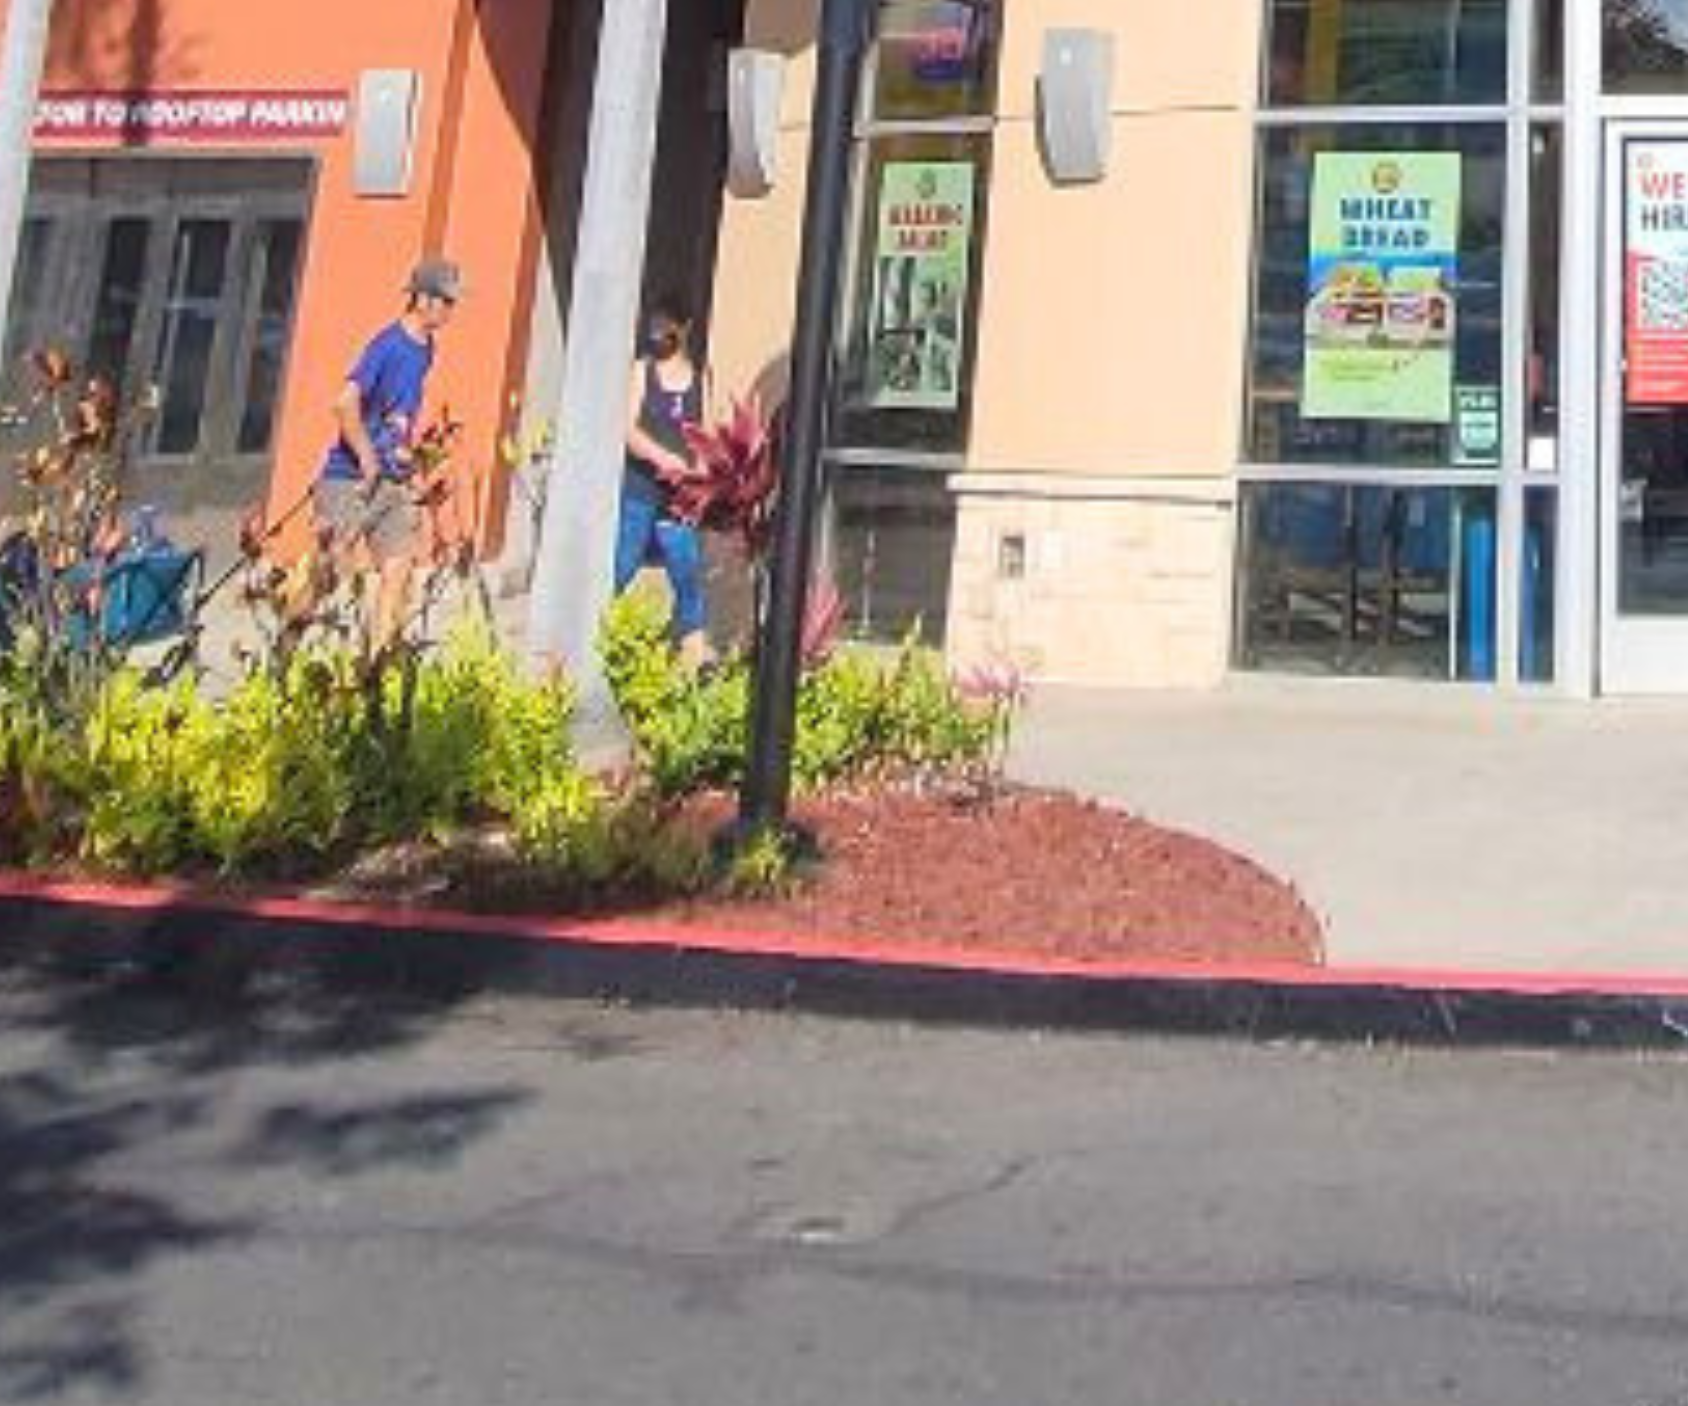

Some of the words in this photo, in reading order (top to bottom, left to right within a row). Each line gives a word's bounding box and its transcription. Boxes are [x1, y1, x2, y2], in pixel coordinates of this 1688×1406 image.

[93, 98, 127, 126] TO
[130, 98, 246, 126] ROOFTOP
[1339, 198, 1433, 220] WHEAT
